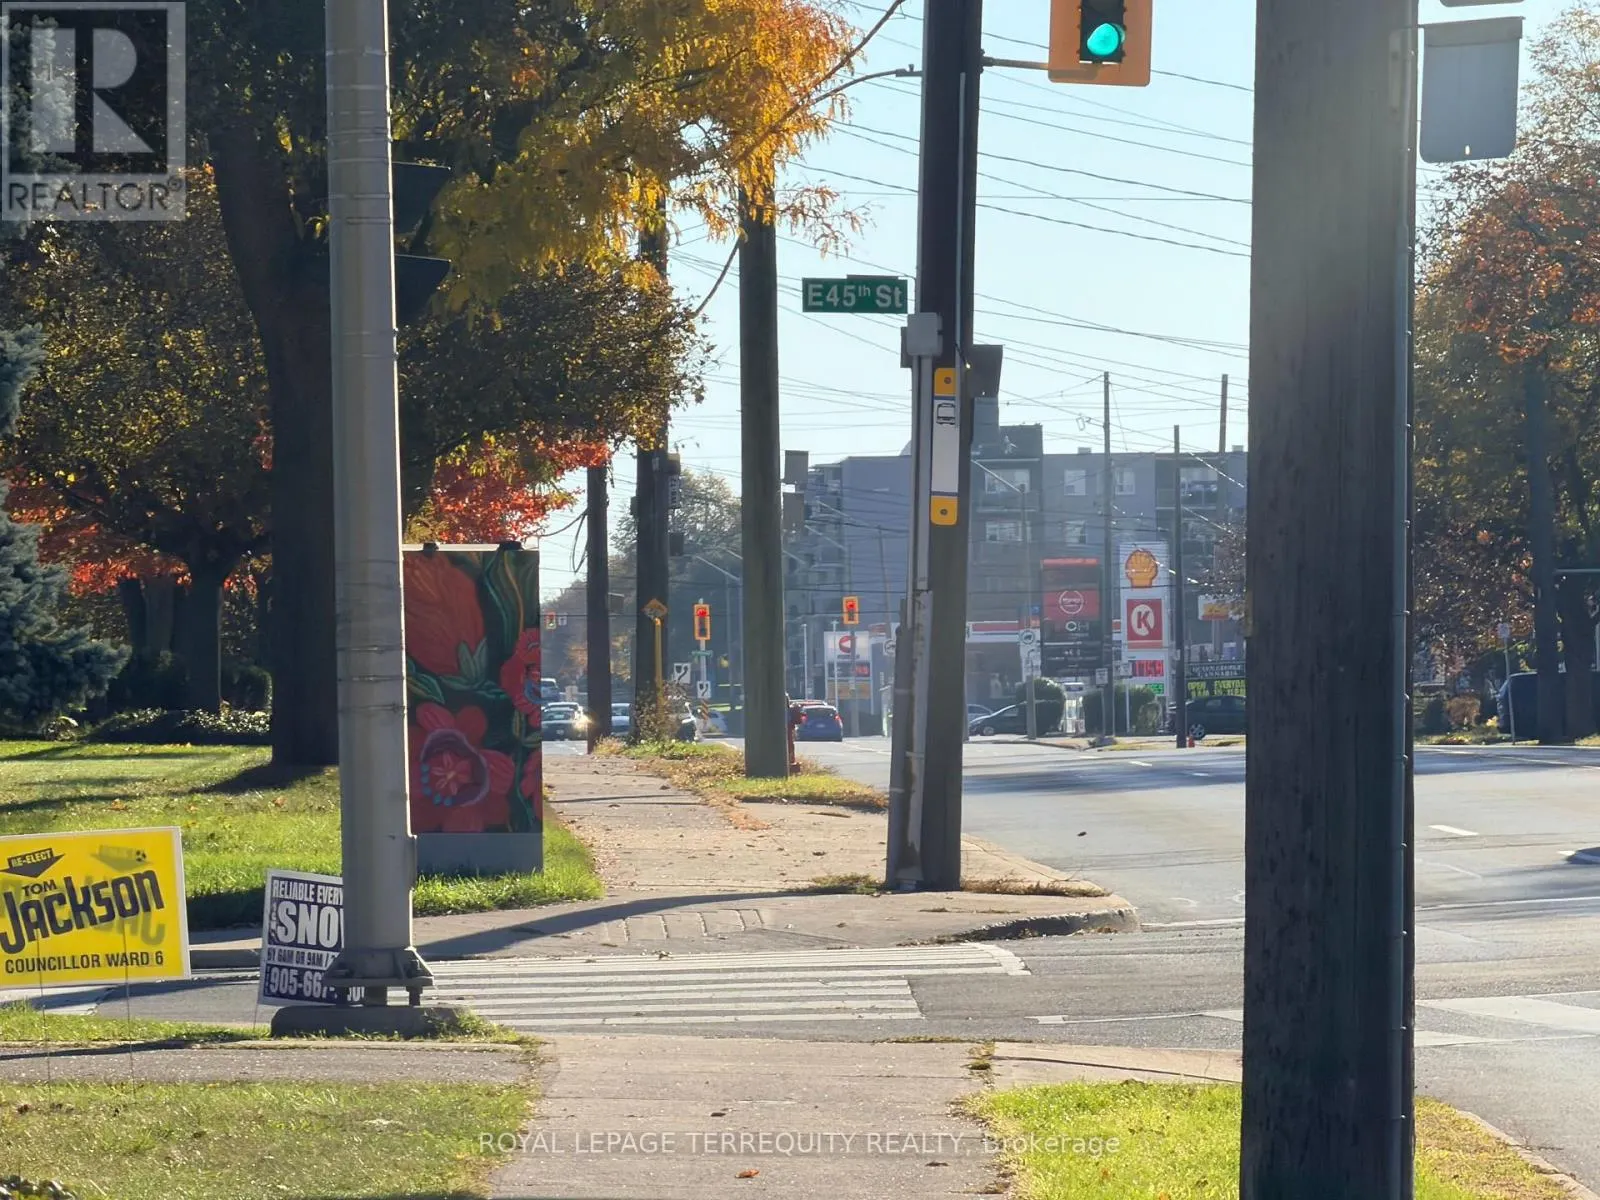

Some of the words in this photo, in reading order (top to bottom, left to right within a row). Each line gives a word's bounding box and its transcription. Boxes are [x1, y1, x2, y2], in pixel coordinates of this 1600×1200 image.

[807, 284, 871, 307] E45th
[875, 284, 902, 308] St
[11, 850, 52, 868] RE-ELECT
[22, 879, 57, 897] TOM
[272, 879, 315, 902] RELIABLE
[277, 900, 344, 949] SNO
[5, 955, 100, 974] COUNCILLOR
[105, 951, 150, 967] WARD
[155, 951, 164, 965] 6
